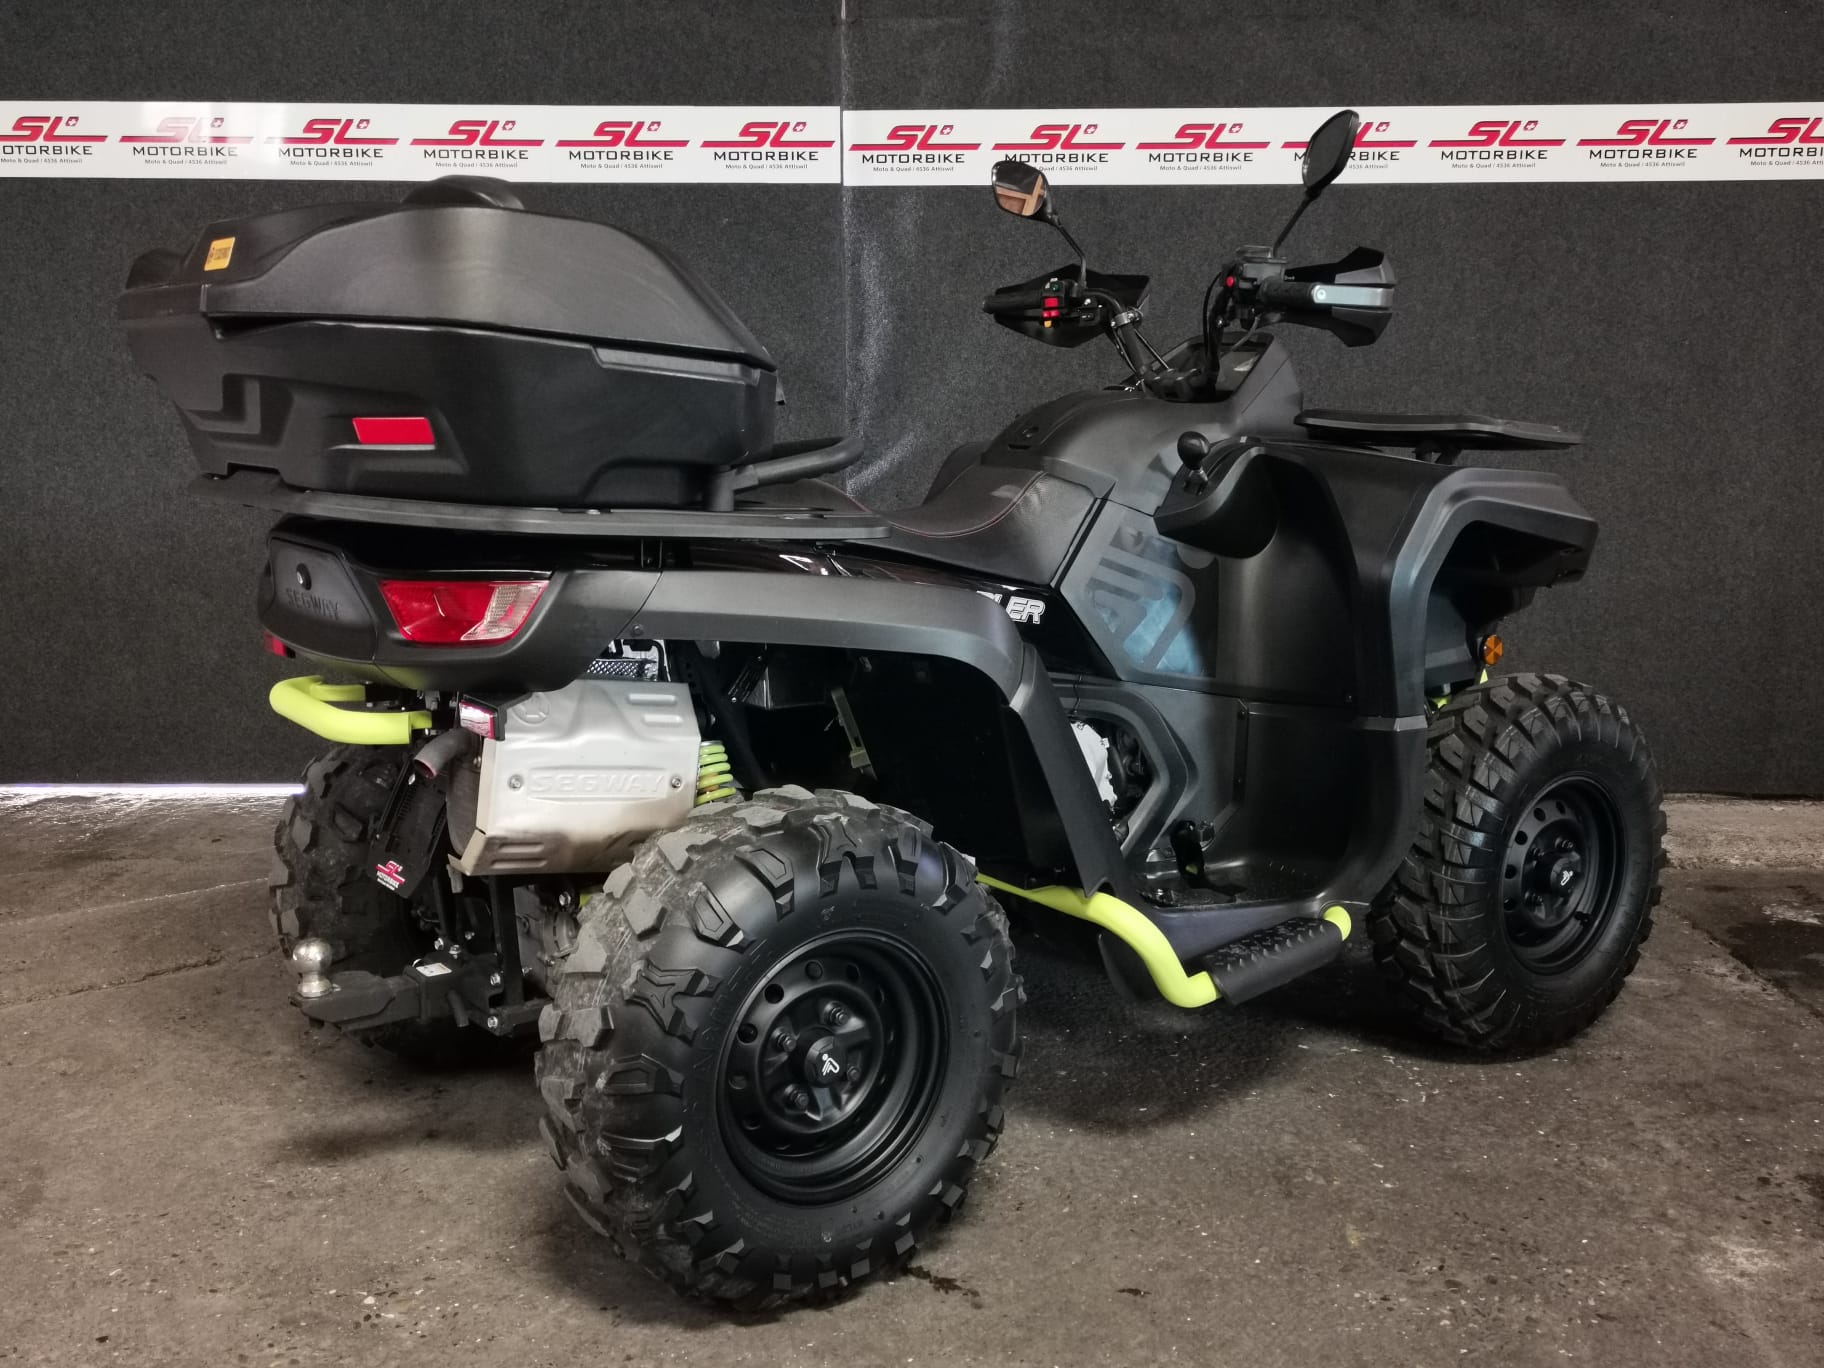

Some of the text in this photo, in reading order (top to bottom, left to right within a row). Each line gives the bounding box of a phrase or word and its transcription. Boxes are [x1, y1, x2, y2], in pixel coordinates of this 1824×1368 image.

[132, 146, 239, 157] MOTORBIKE
[279, 147, 385, 158] MOTORBIKE
[423, 149, 529, 160] MOTORBIKE
[568, 150, 674, 161] MOTORBIKE
[713, 151, 819, 161] MOTORBIKE
[1440, 149, 1548, 161] MOTORBIKE
[1589, 148, 1698, 160] MOTORBIKE
[862, 153, 965, 164] MOTORBIKE
[1004, 153, 1109, 163] MOTORBIKE
[1148, 152, 1254, 163] MOTORBIKE
[285, 587, 339, 620] SEGWAY
[529, 773, 665, 793] SEGWAY
